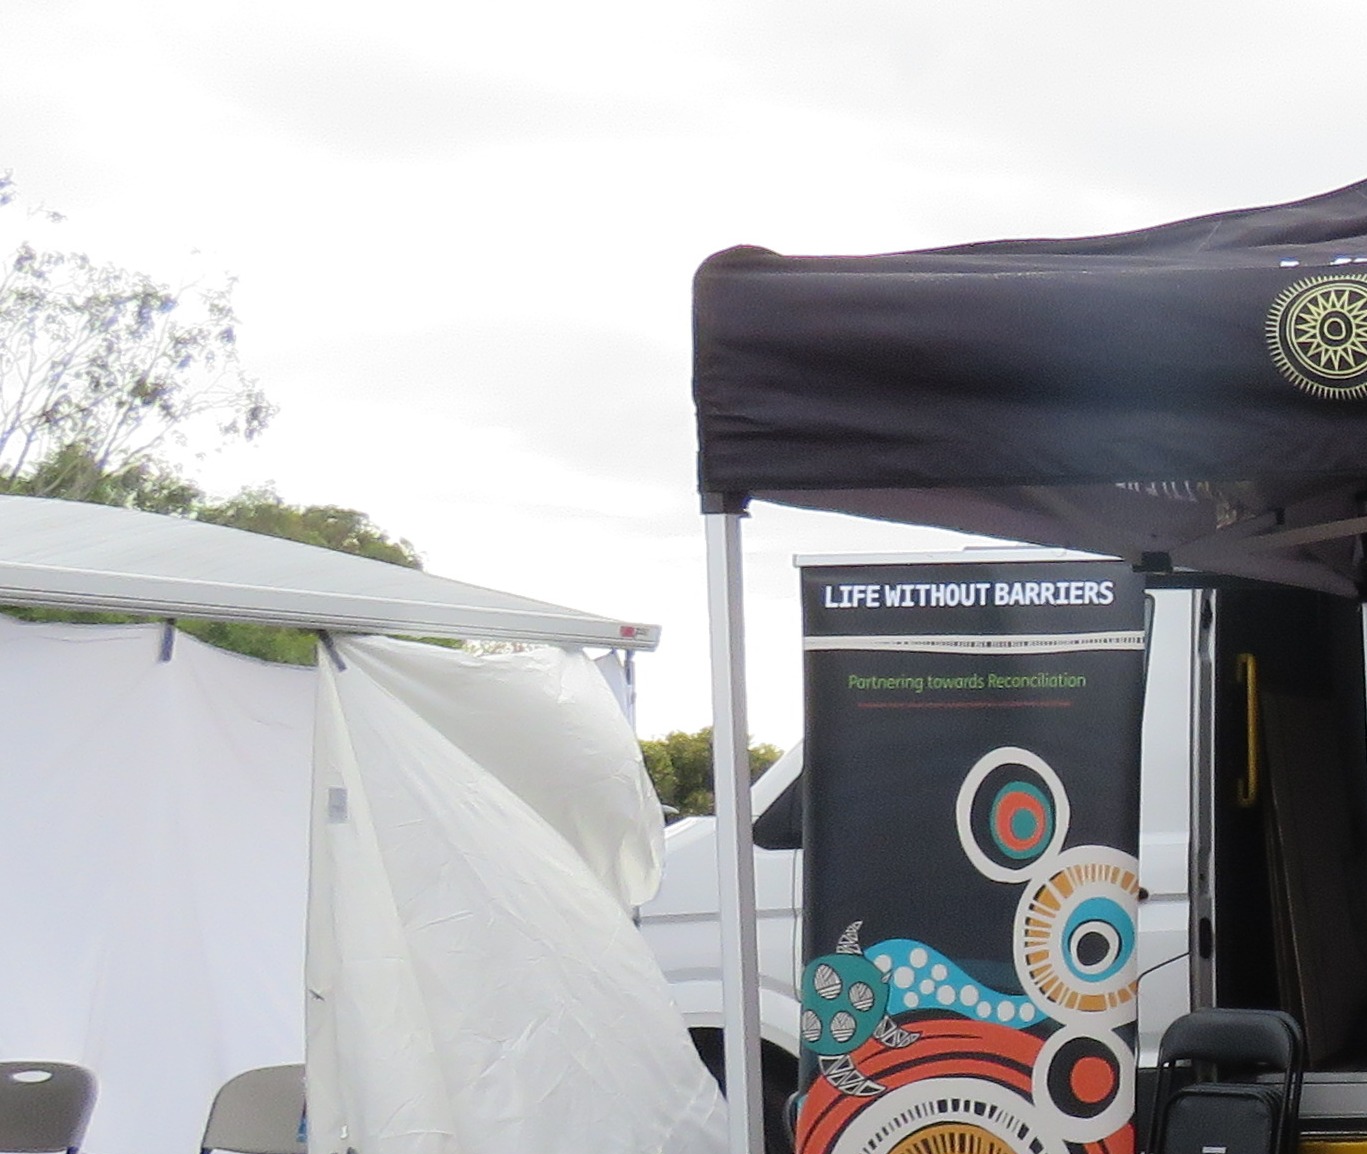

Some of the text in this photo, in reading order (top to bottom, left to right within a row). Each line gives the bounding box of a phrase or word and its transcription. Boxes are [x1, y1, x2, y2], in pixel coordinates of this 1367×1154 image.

[824, 580, 1114, 609] LIFE WITHOUT BARRIERS
[848, 672, 1087, 693] Partnering towards Reconciliation
